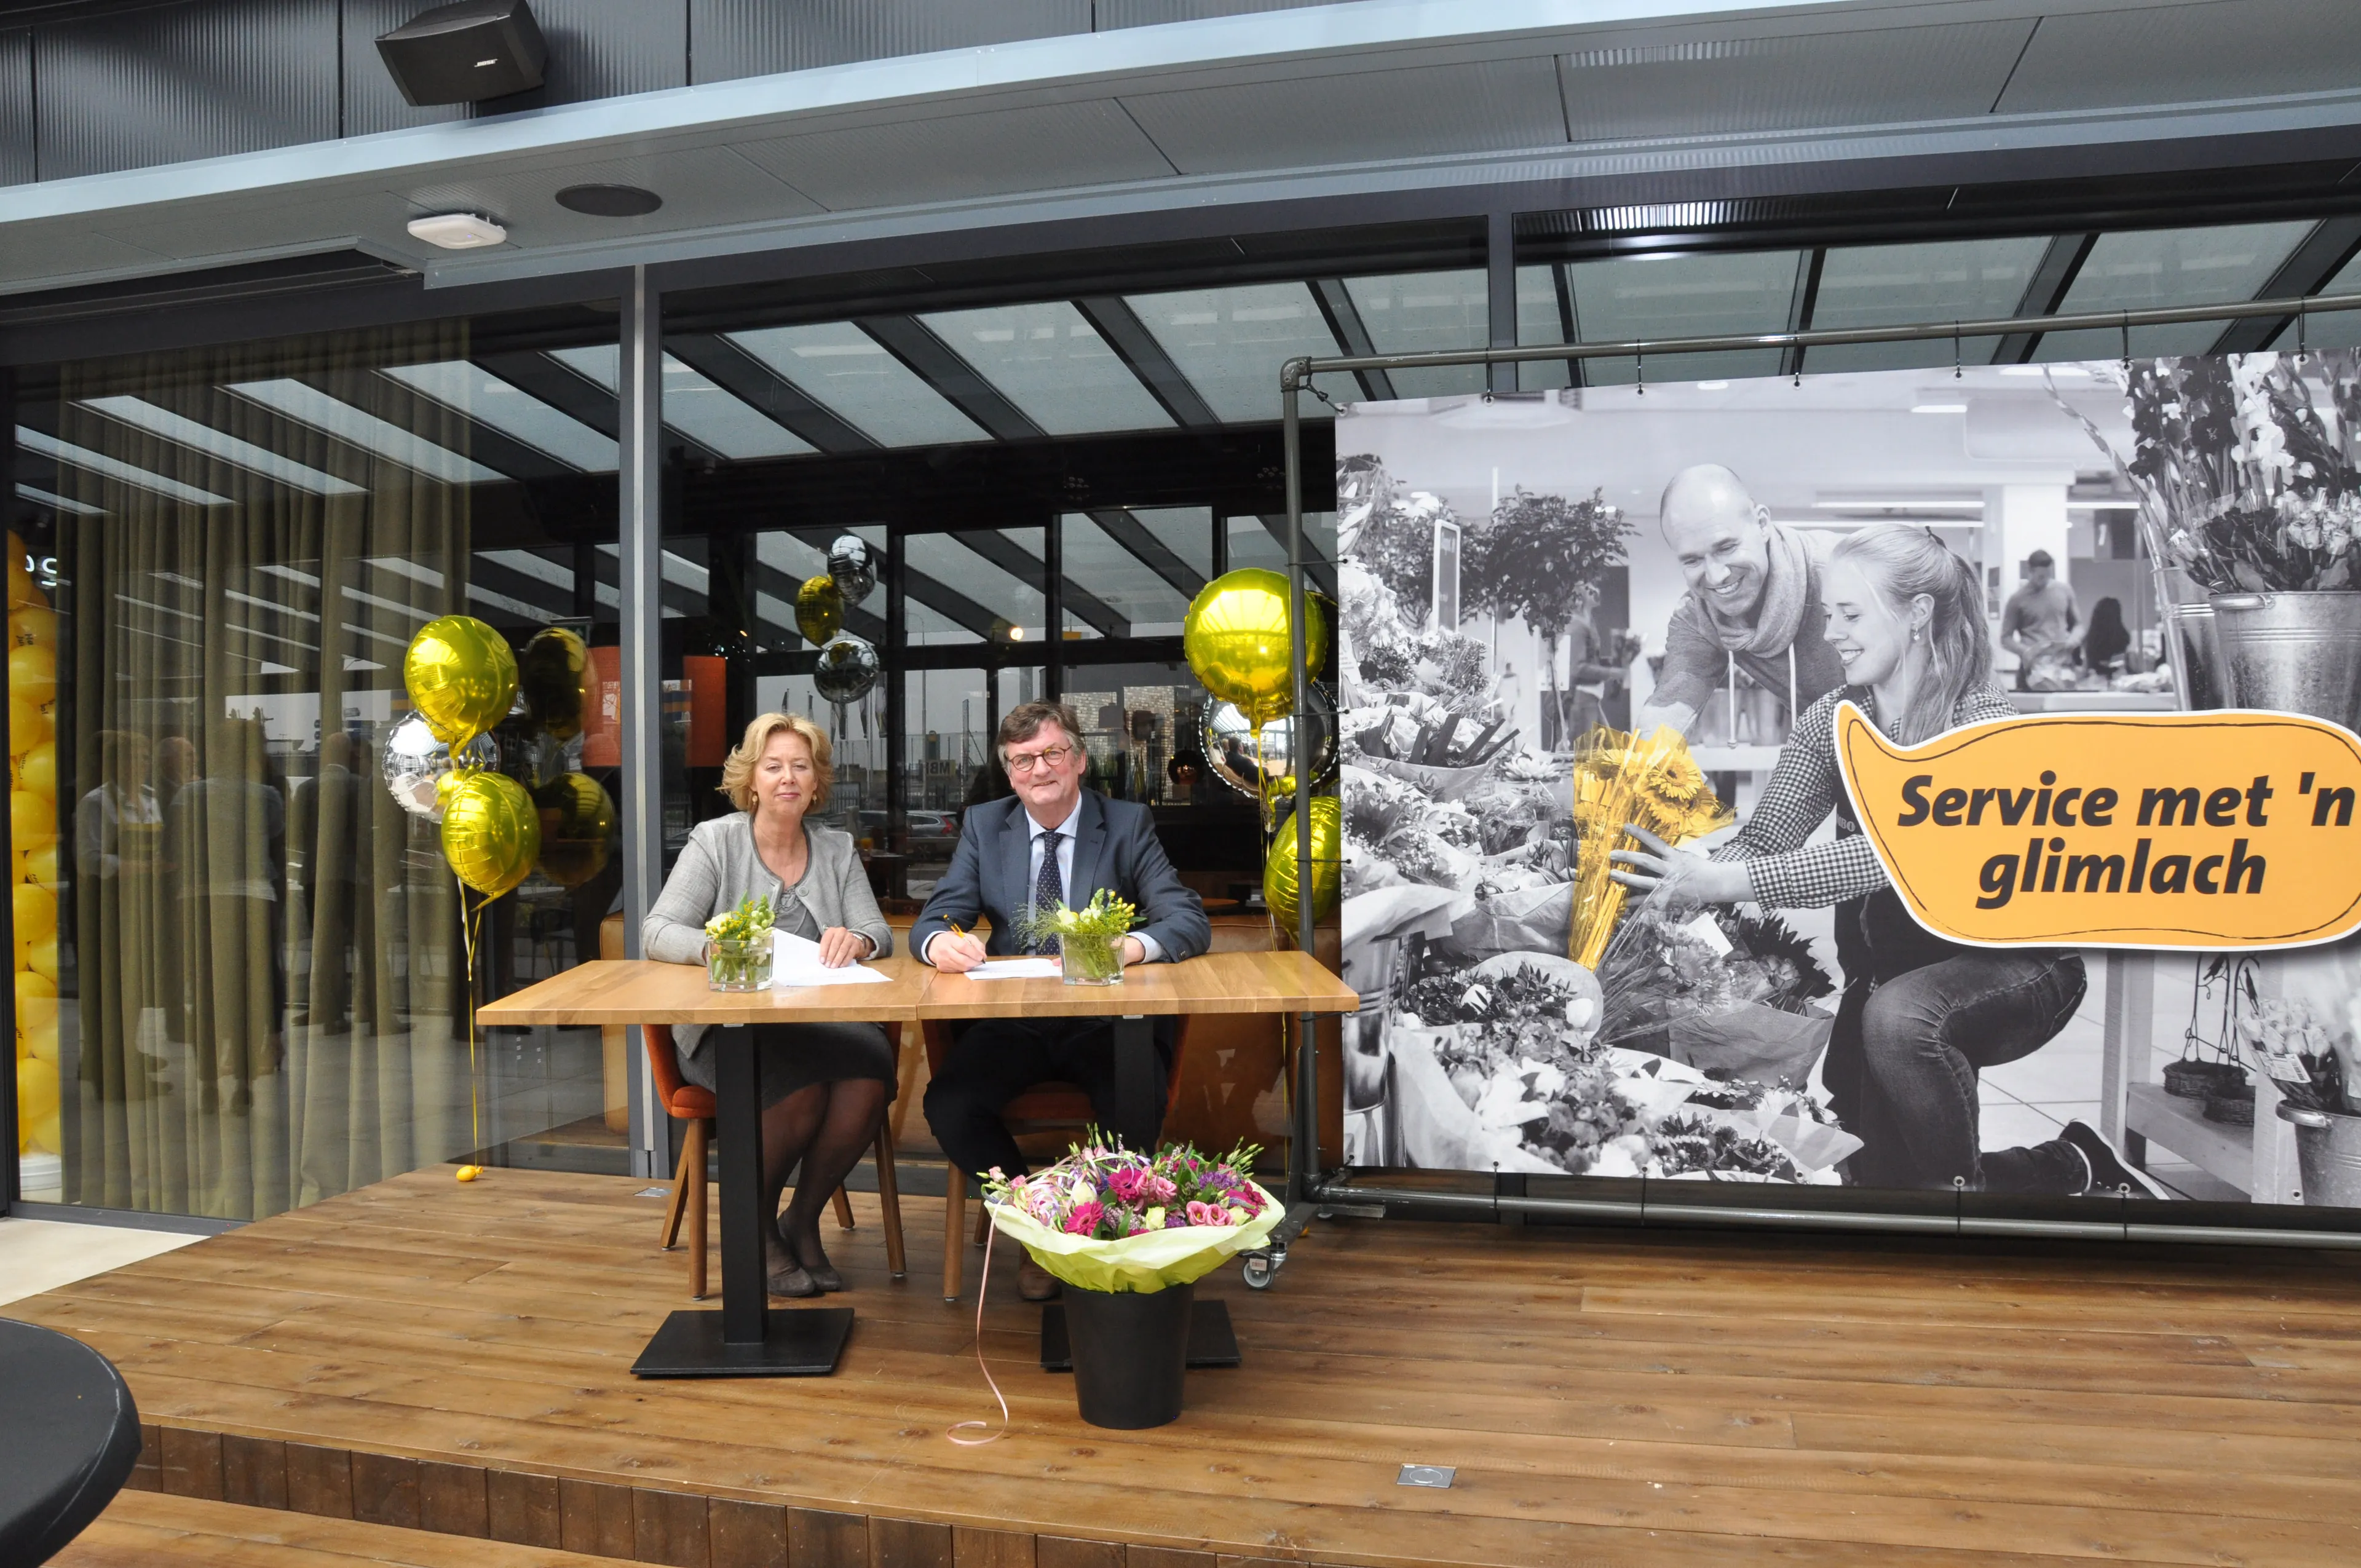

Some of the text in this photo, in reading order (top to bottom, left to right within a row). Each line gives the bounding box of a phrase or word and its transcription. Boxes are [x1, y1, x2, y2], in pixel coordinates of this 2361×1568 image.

[1897, 770, 2355, 827] Service met 'n
[1975, 837, 2266, 910] glimlach
